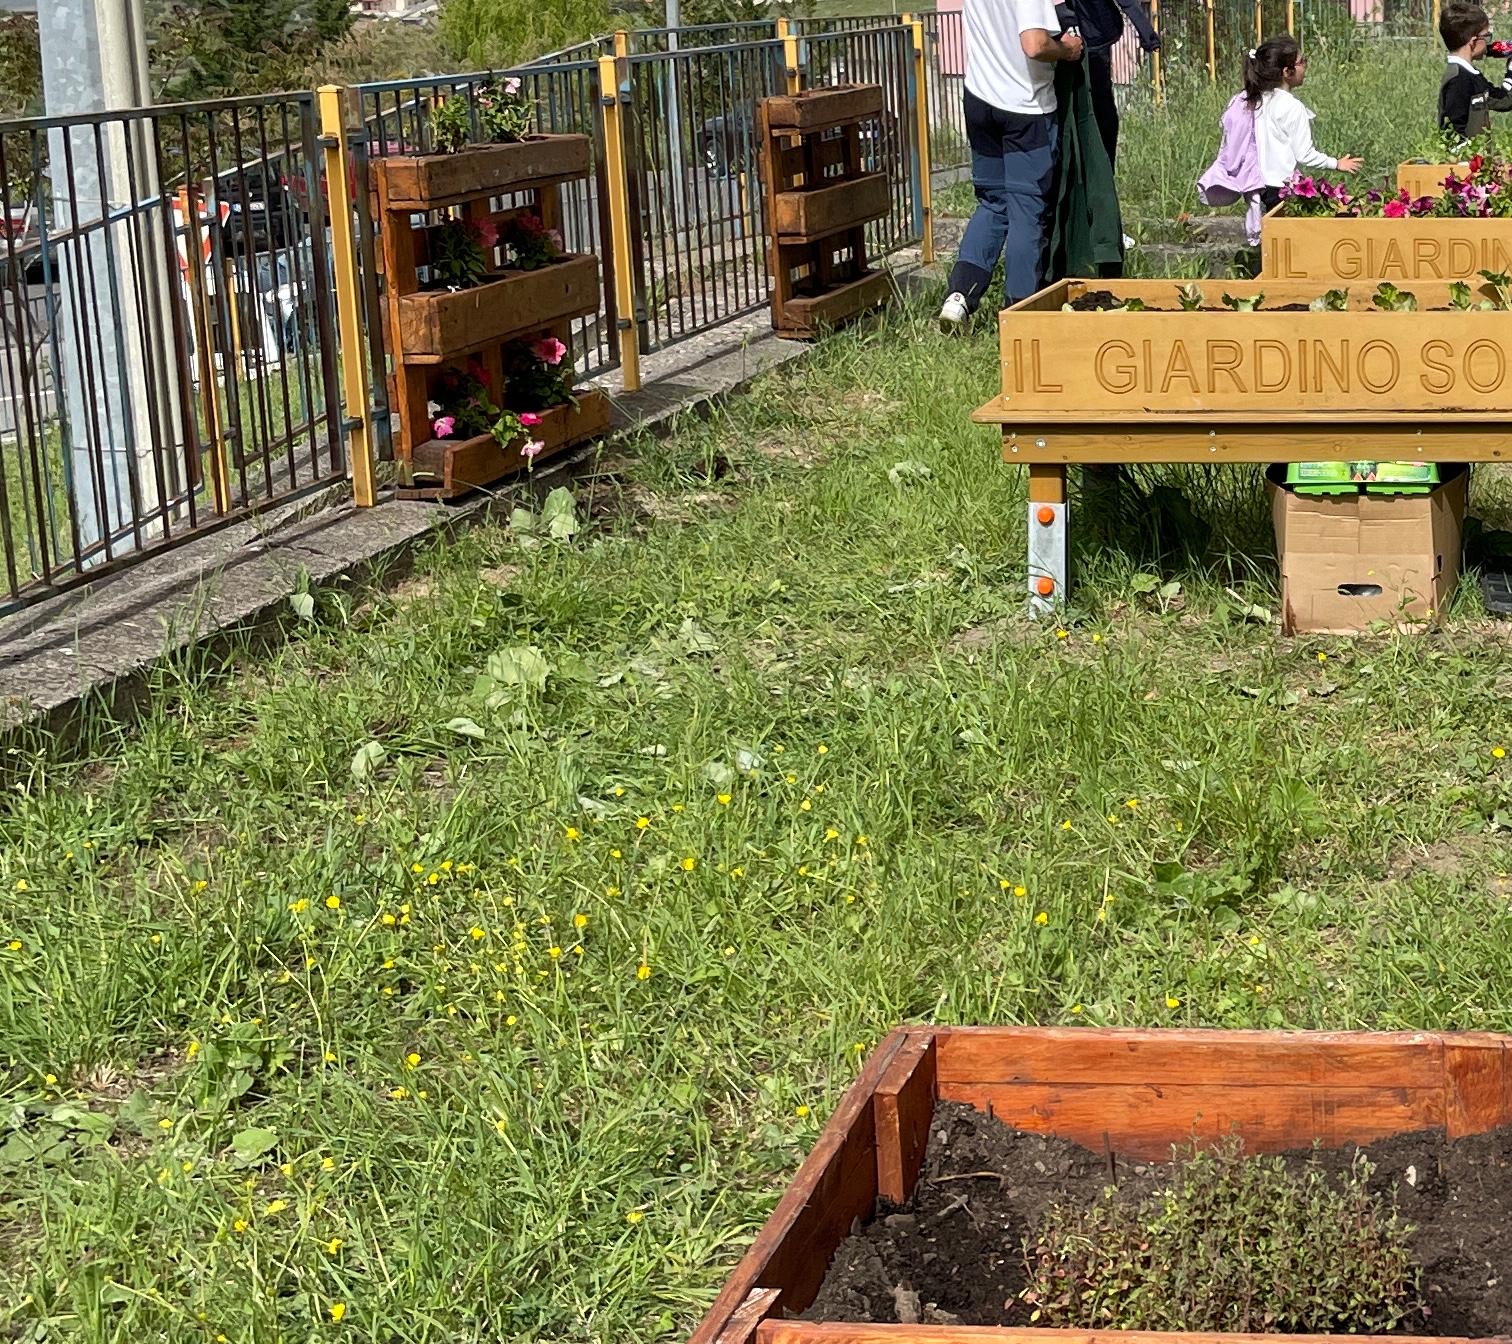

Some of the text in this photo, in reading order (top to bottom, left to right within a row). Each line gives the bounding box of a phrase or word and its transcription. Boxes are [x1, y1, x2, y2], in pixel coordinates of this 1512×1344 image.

[1271, 237, 1308, 279] IL
[1013, 338, 1064, 393] IL
[1094, 339, 1401, 395] GIARDINO
